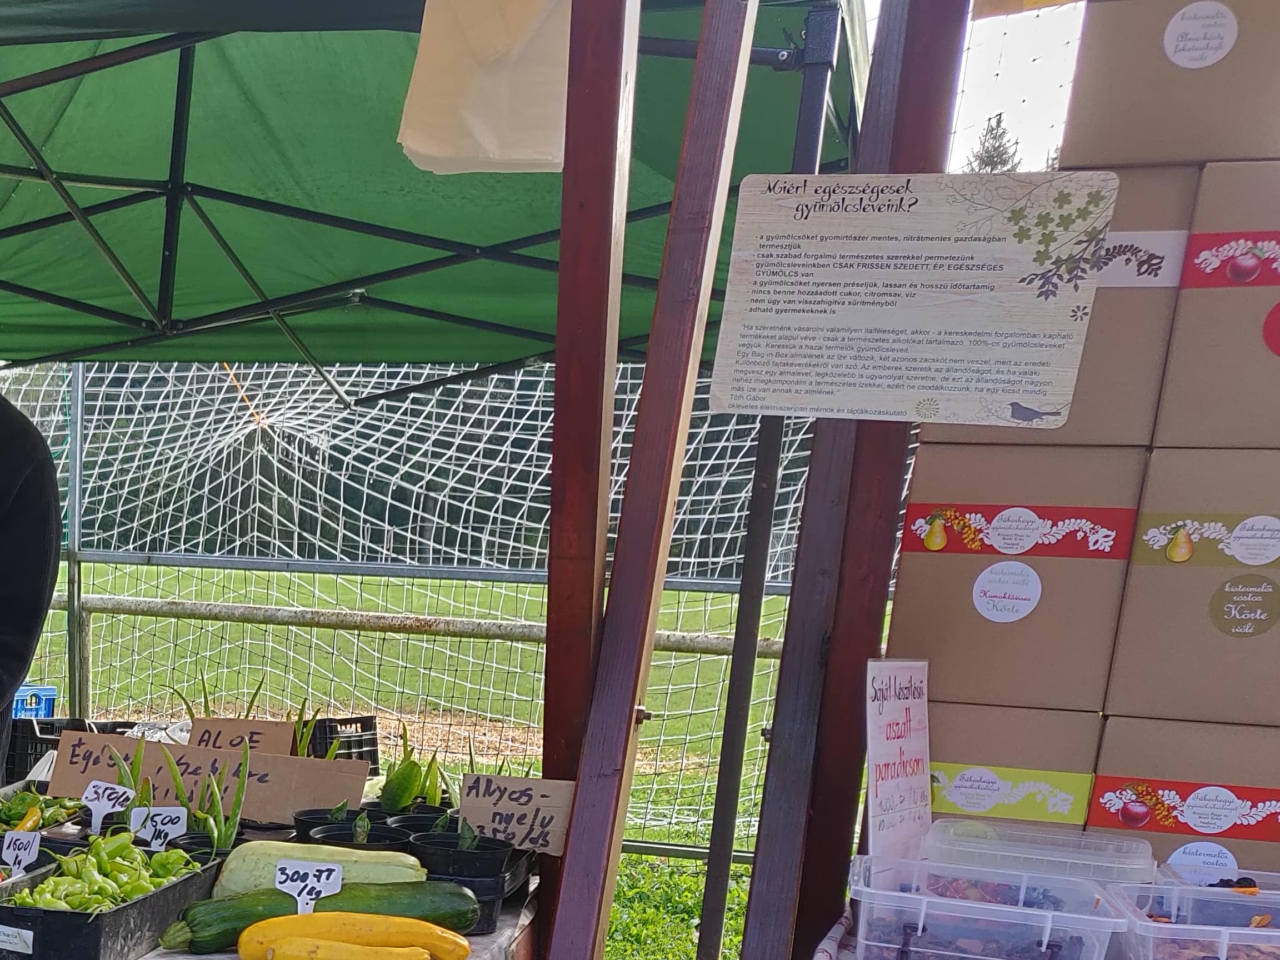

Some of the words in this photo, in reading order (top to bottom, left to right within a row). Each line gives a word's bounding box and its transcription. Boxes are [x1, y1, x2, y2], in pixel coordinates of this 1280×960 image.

[761, 179, 807, 195] Miért
[814, 179, 913, 202] egészségesek
[794, 197, 919, 221] gyümölcsleveink?
[871, 235, 900, 243] mentes,
[953, 235, 1007, 244] gazdaságban
[759, 243, 802, 251] termesztjük
[893, 263, 931, 271] SZEDETT,
[947, 263, 1004, 271] EGÉSZSÉGES
[950, 283, 995, 291] időtartamig
[839, 290, 862, 298] cukor,
[755, 324, 791, 332] szeretnénk
[826, 326, 863, 335] valamilyen
[944, 329, 992, 337] kereskedelmi
[994, 331, 1041, 339] forgalomban
[1043, 332, 1074, 340] kapható
[847, 336, 890, 344] természetes
[728, 402, 758, 410] okleveles
[885, 708, 912, 741] aszalt
[197, 729, 263, 749] ALOE
[875, 747, 925, 798] paradicsom
[278, 866, 310, 885] 300
